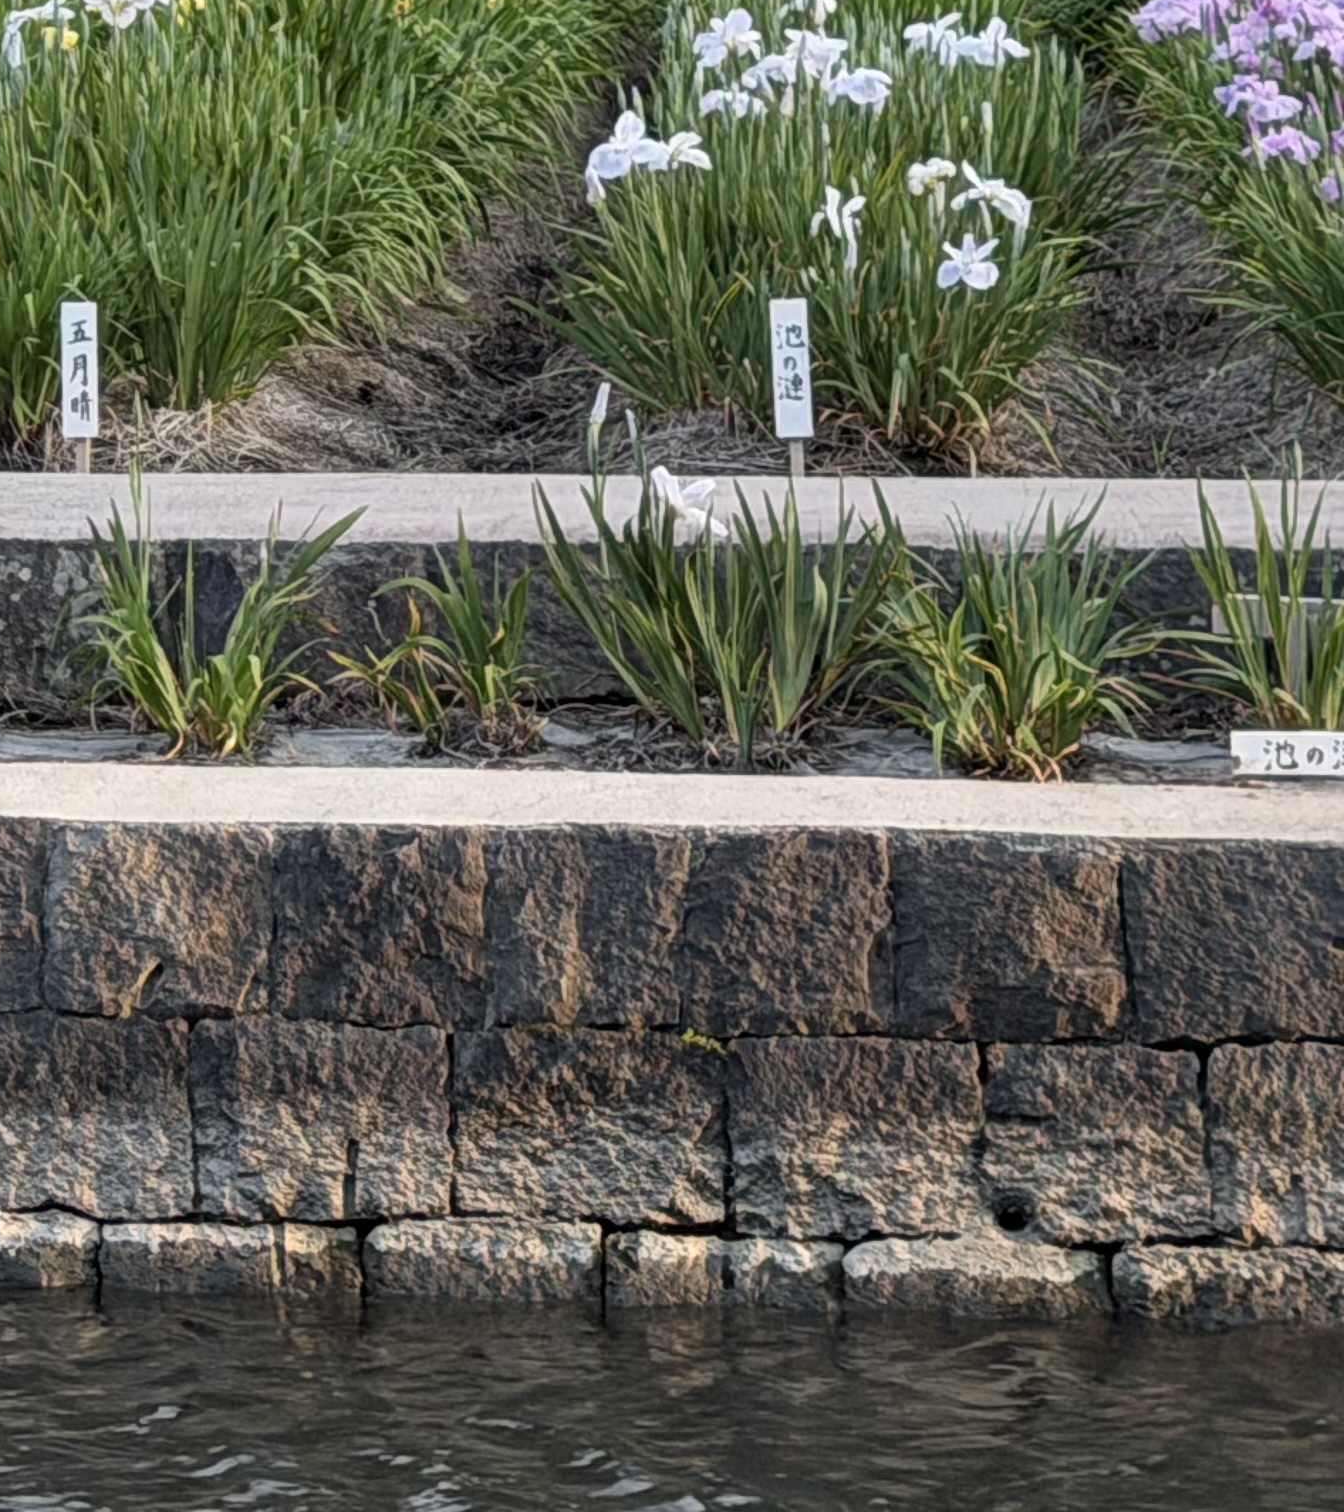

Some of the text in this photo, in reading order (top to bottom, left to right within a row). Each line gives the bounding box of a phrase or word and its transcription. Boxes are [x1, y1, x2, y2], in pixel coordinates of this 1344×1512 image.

[67, 319, 93, 421] 五月晴
[775, 324, 806, 401] 池の漣
